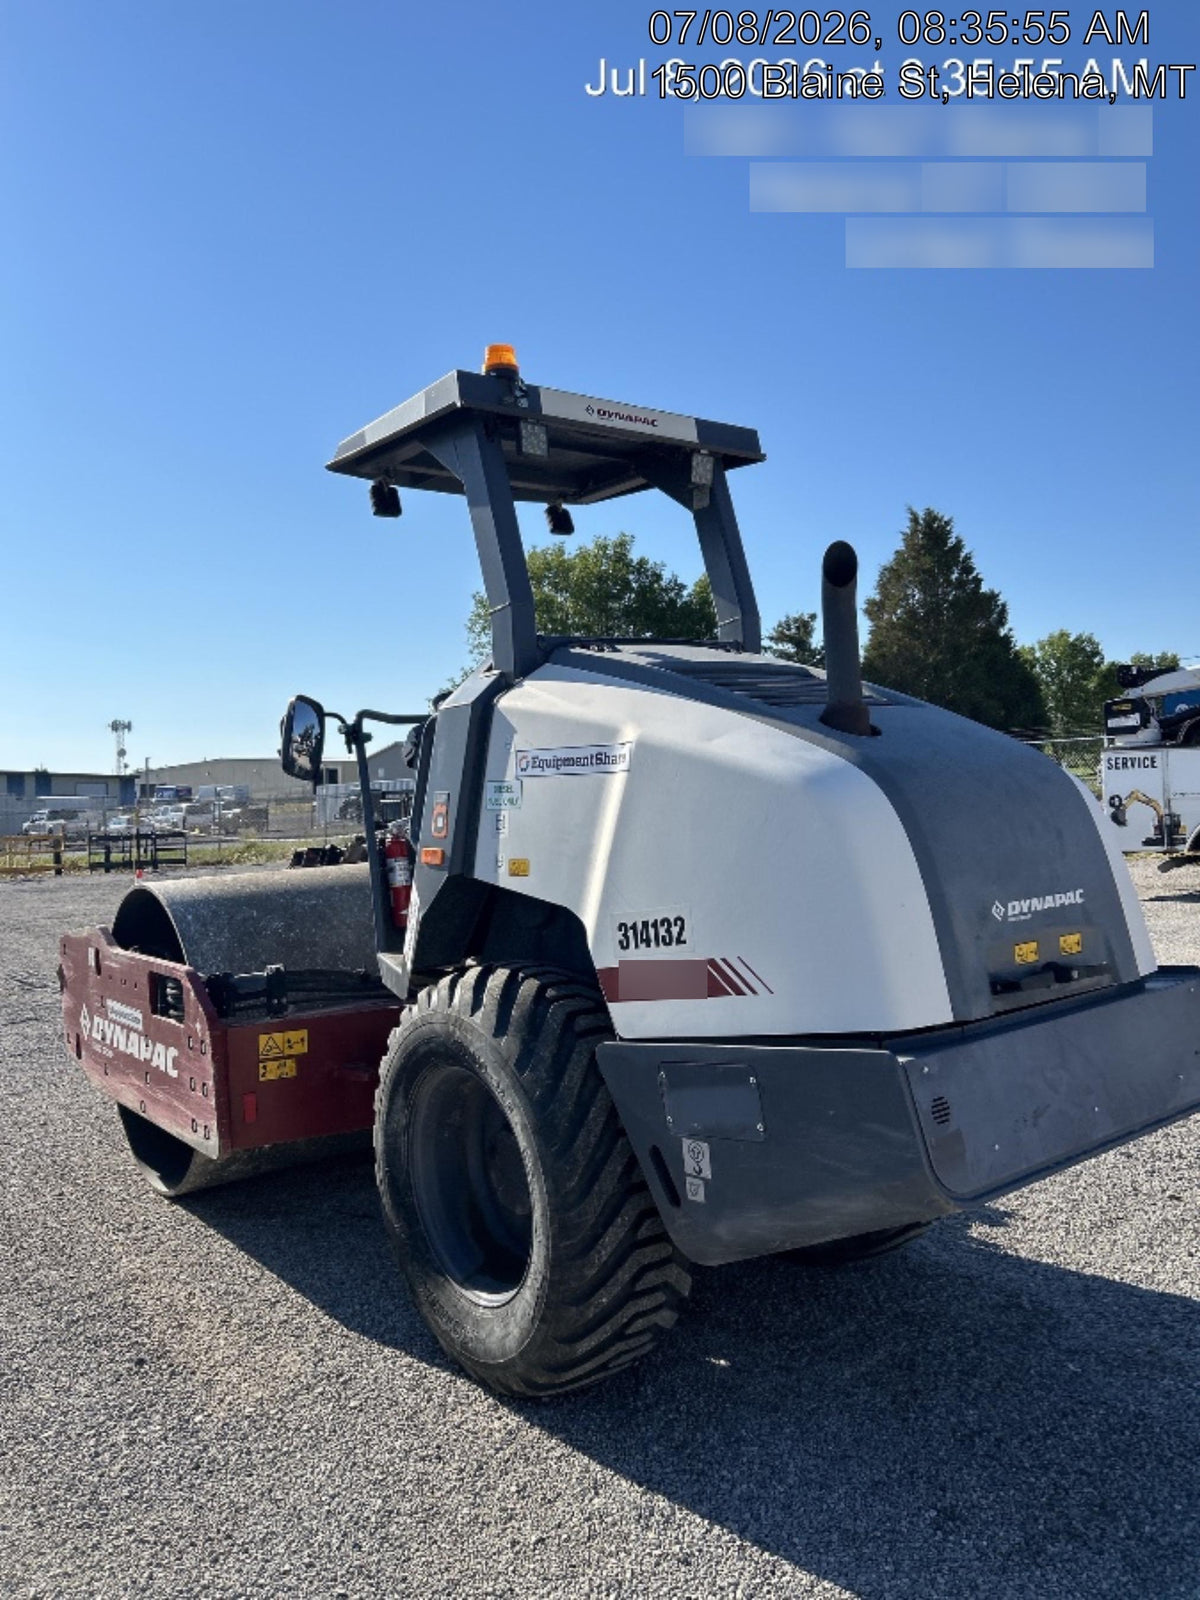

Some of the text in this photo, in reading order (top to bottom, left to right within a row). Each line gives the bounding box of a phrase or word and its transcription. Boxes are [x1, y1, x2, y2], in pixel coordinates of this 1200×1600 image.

[597, 408, 658, 427] DYNAPAC
[1106, 756, 1158, 770] SERVICE
[1007, 888, 1085, 916] DYNAPAC
[617, 915, 687, 951] 314132
[91, 1014, 178, 1078] DYNAPAC
